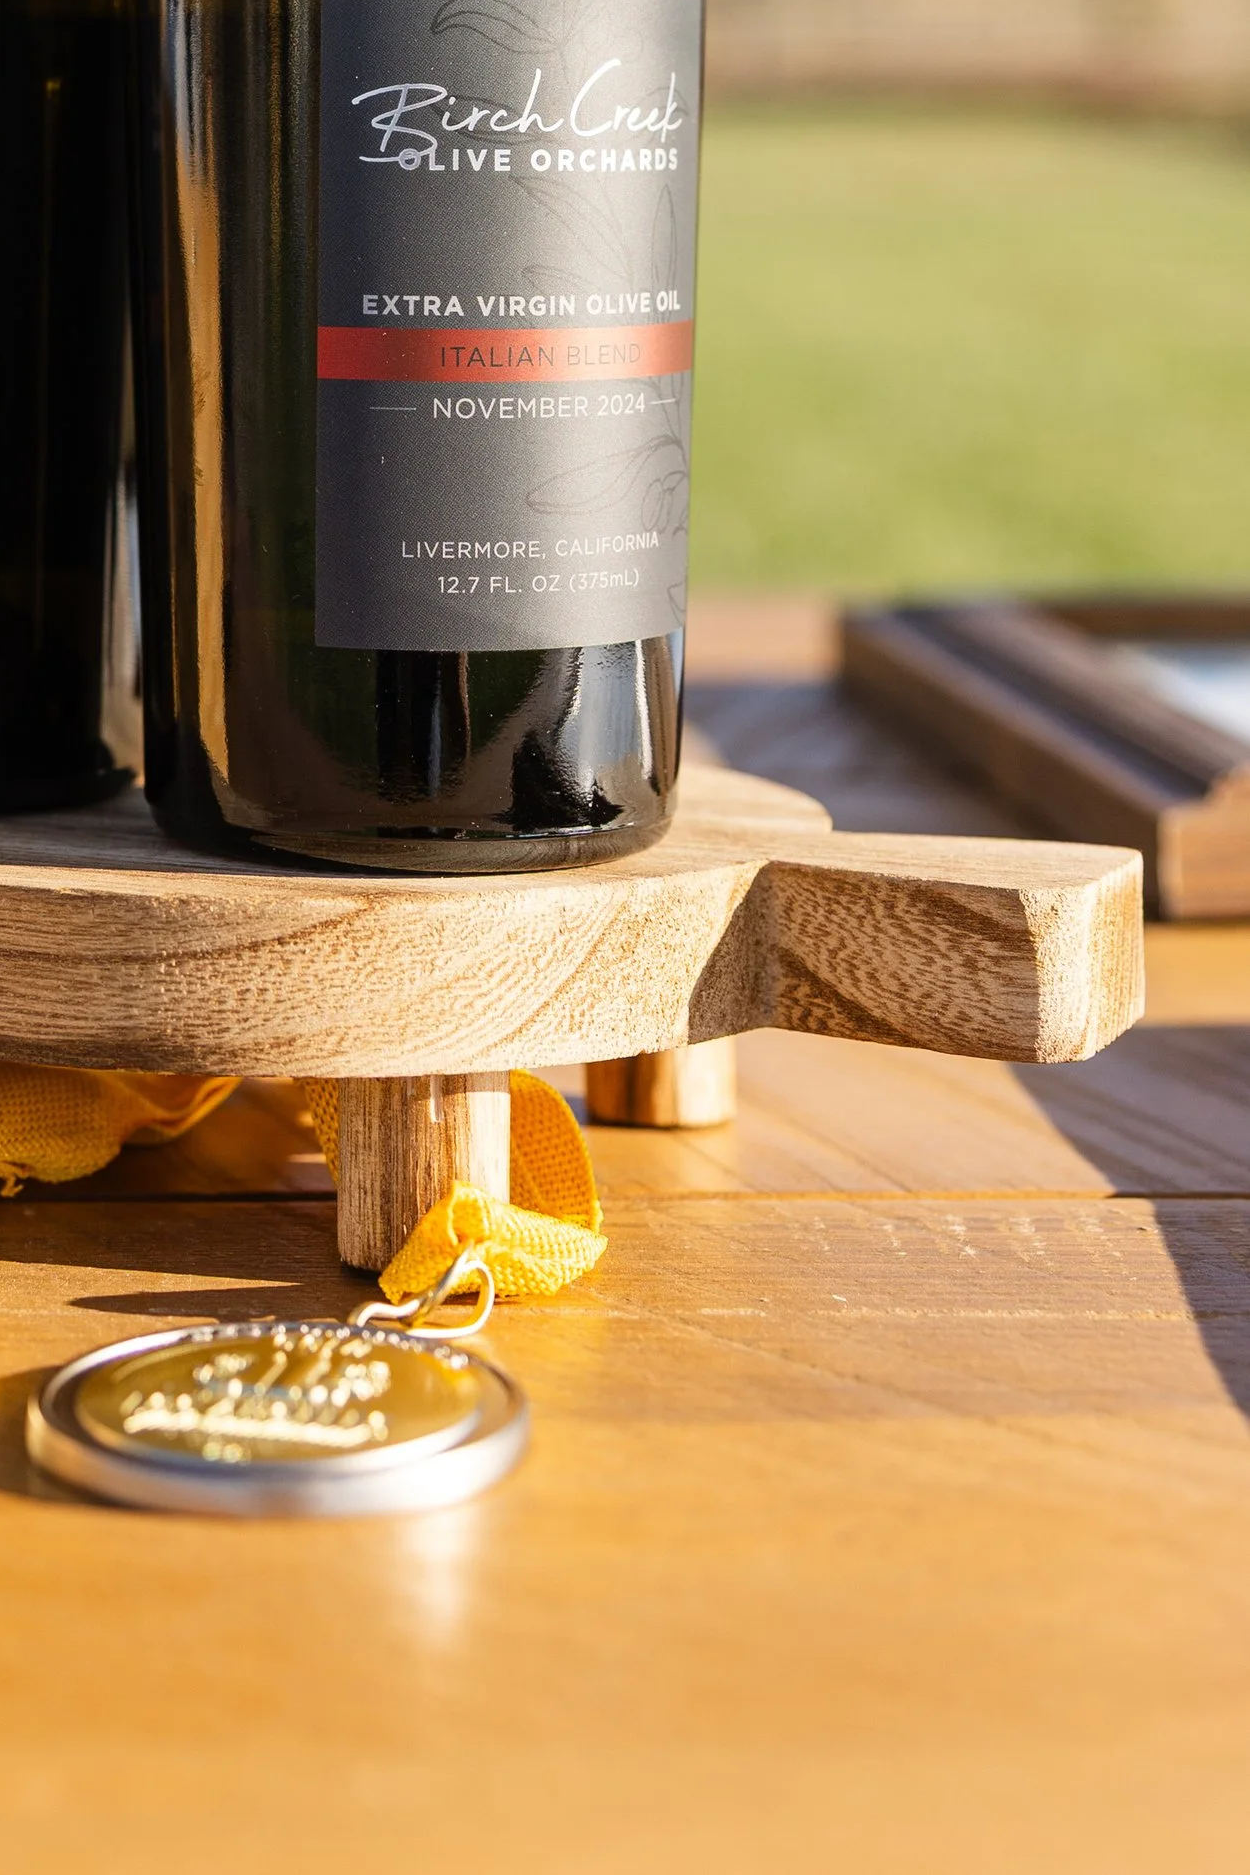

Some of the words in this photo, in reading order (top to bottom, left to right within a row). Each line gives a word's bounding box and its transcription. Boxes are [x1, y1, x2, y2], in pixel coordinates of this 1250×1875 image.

[352, 68, 565, 163] Birch
[569, 58, 683, 143] Creek
[398, 147, 512, 172] OLIVE
[530, 147, 679, 172] ORCHARDS
[362, 293, 464, 317] EXTRA
[477, 293, 577, 318] VIRGIN
[586, 292, 651, 315] OLIVE
[656, 290, 682, 312] OIL
[440, 344, 556, 369] ITALIAN
[566, 342, 642, 367] BLEND
[432, 396, 589, 420] NOVEMBER
[596, 393, 647, 417] 2024
[401, 541, 547, 560] LIVERMORE,
[554, 531, 660, 558] CALIFORNIA
[437, 576, 480, 595] 12.7
[489, 576, 523, 594] FL.
[531, 575, 561, 593] OZ
[568, 568, 641, 593] (375mL)
